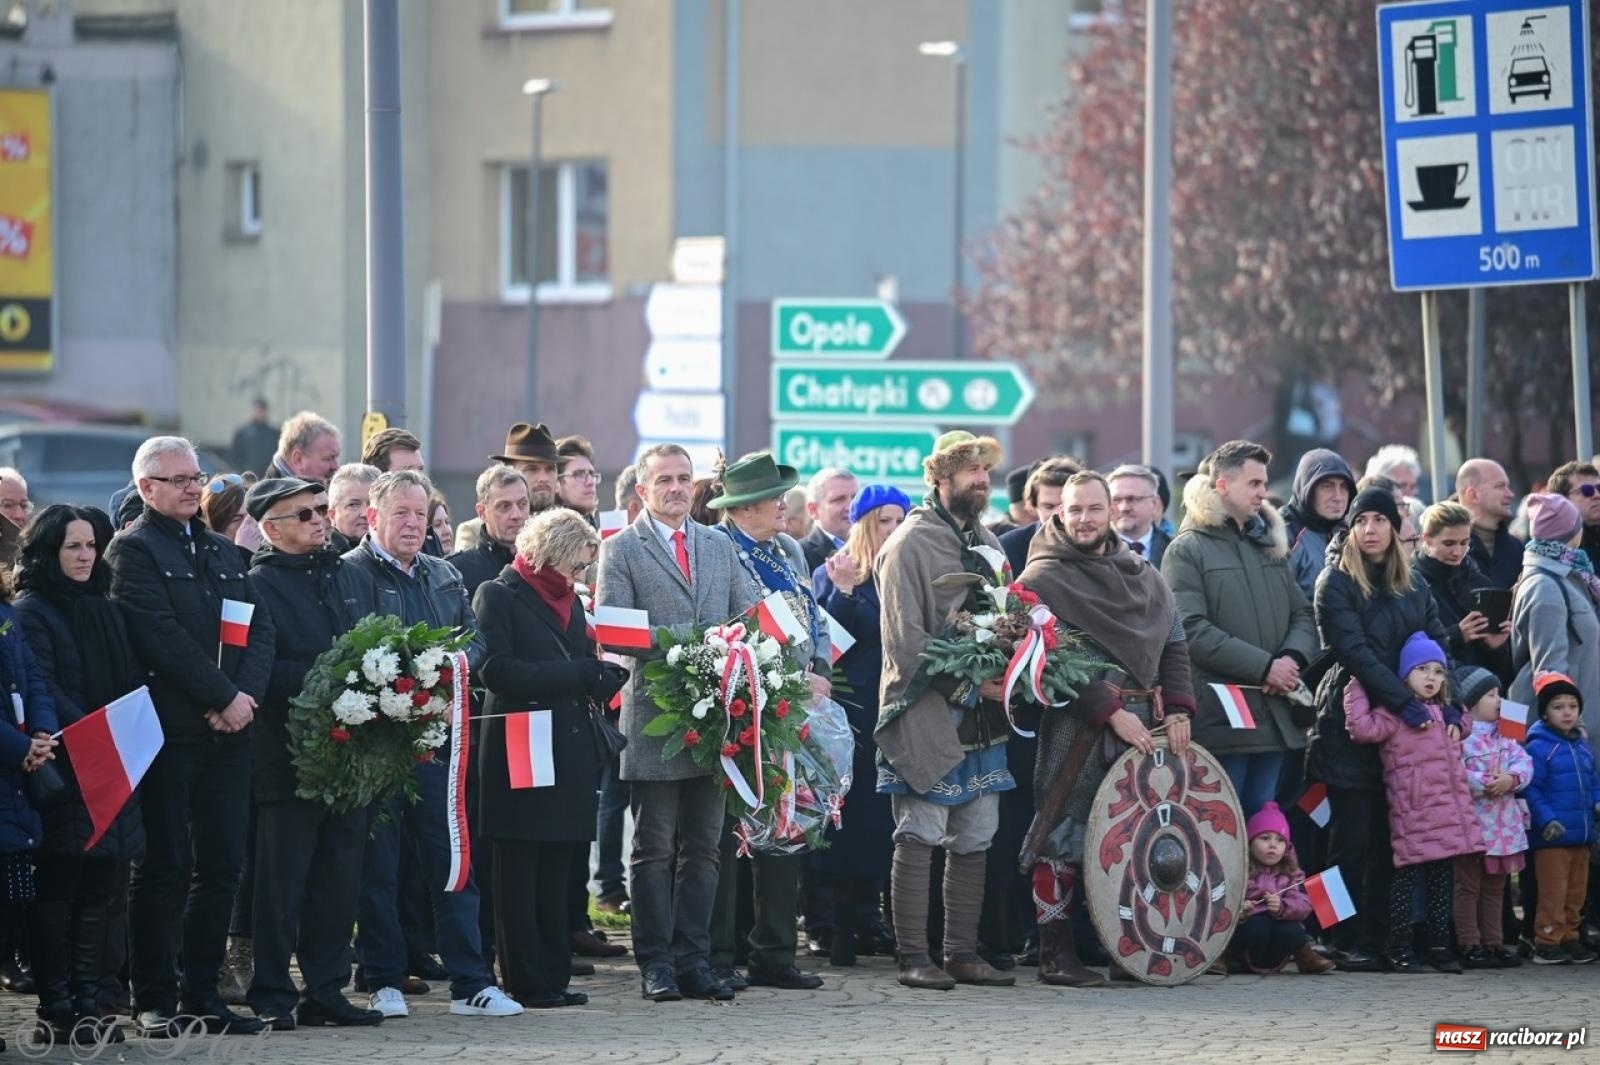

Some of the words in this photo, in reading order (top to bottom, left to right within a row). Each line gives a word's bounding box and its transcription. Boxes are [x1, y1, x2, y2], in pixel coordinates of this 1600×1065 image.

[1479, 245, 1521, 272] 500
[1524, 254, 1541, 269] m
[789, 312, 873, 352] Opole
[787, 374, 908, 415] Chałupki
[785, 436, 922, 473] Głubczyce
